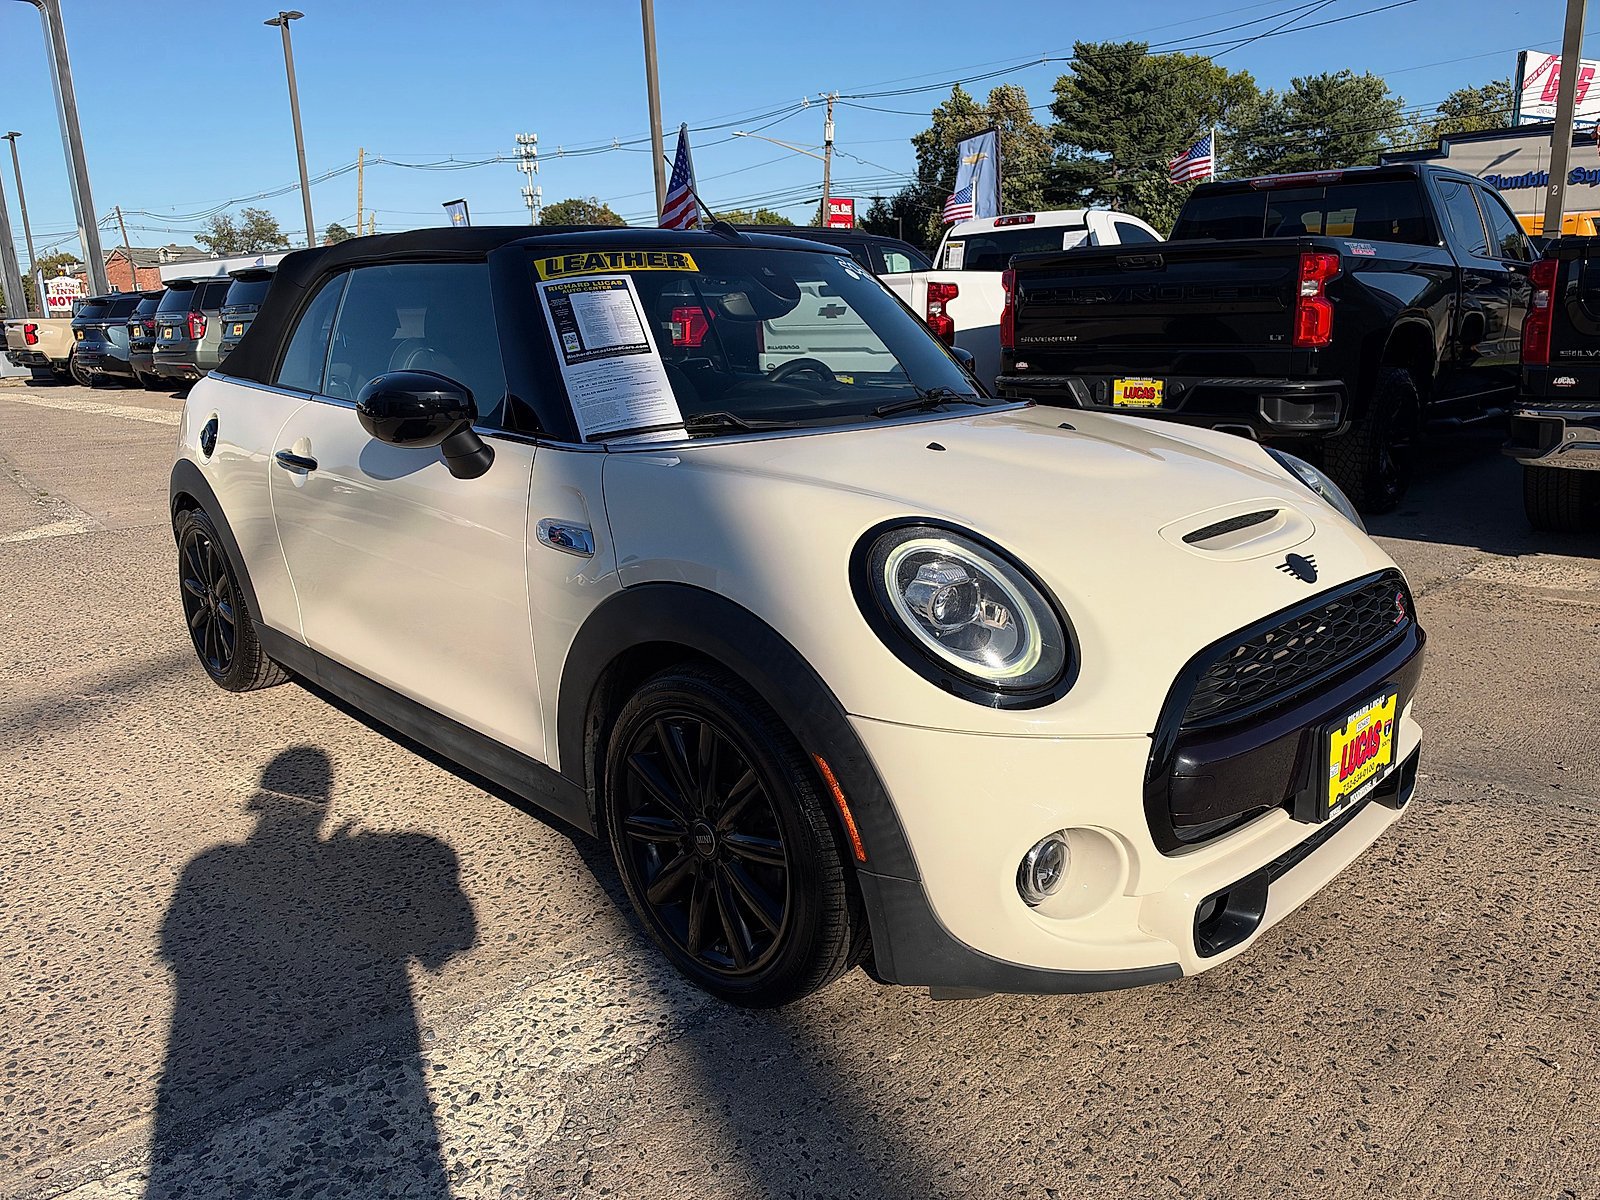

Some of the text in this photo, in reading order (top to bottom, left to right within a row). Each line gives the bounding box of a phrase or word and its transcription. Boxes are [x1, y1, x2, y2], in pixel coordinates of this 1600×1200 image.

[1541, 64, 1596, 105] GS
[1551, 184, 1559, 196] 2
[546, 252, 690, 276] LEATHER
[548, 281, 589, 292] RICHARD
[1123, 386, 1155, 400] LUCAS
[1339, 719, 1382, 783] LUCAS
